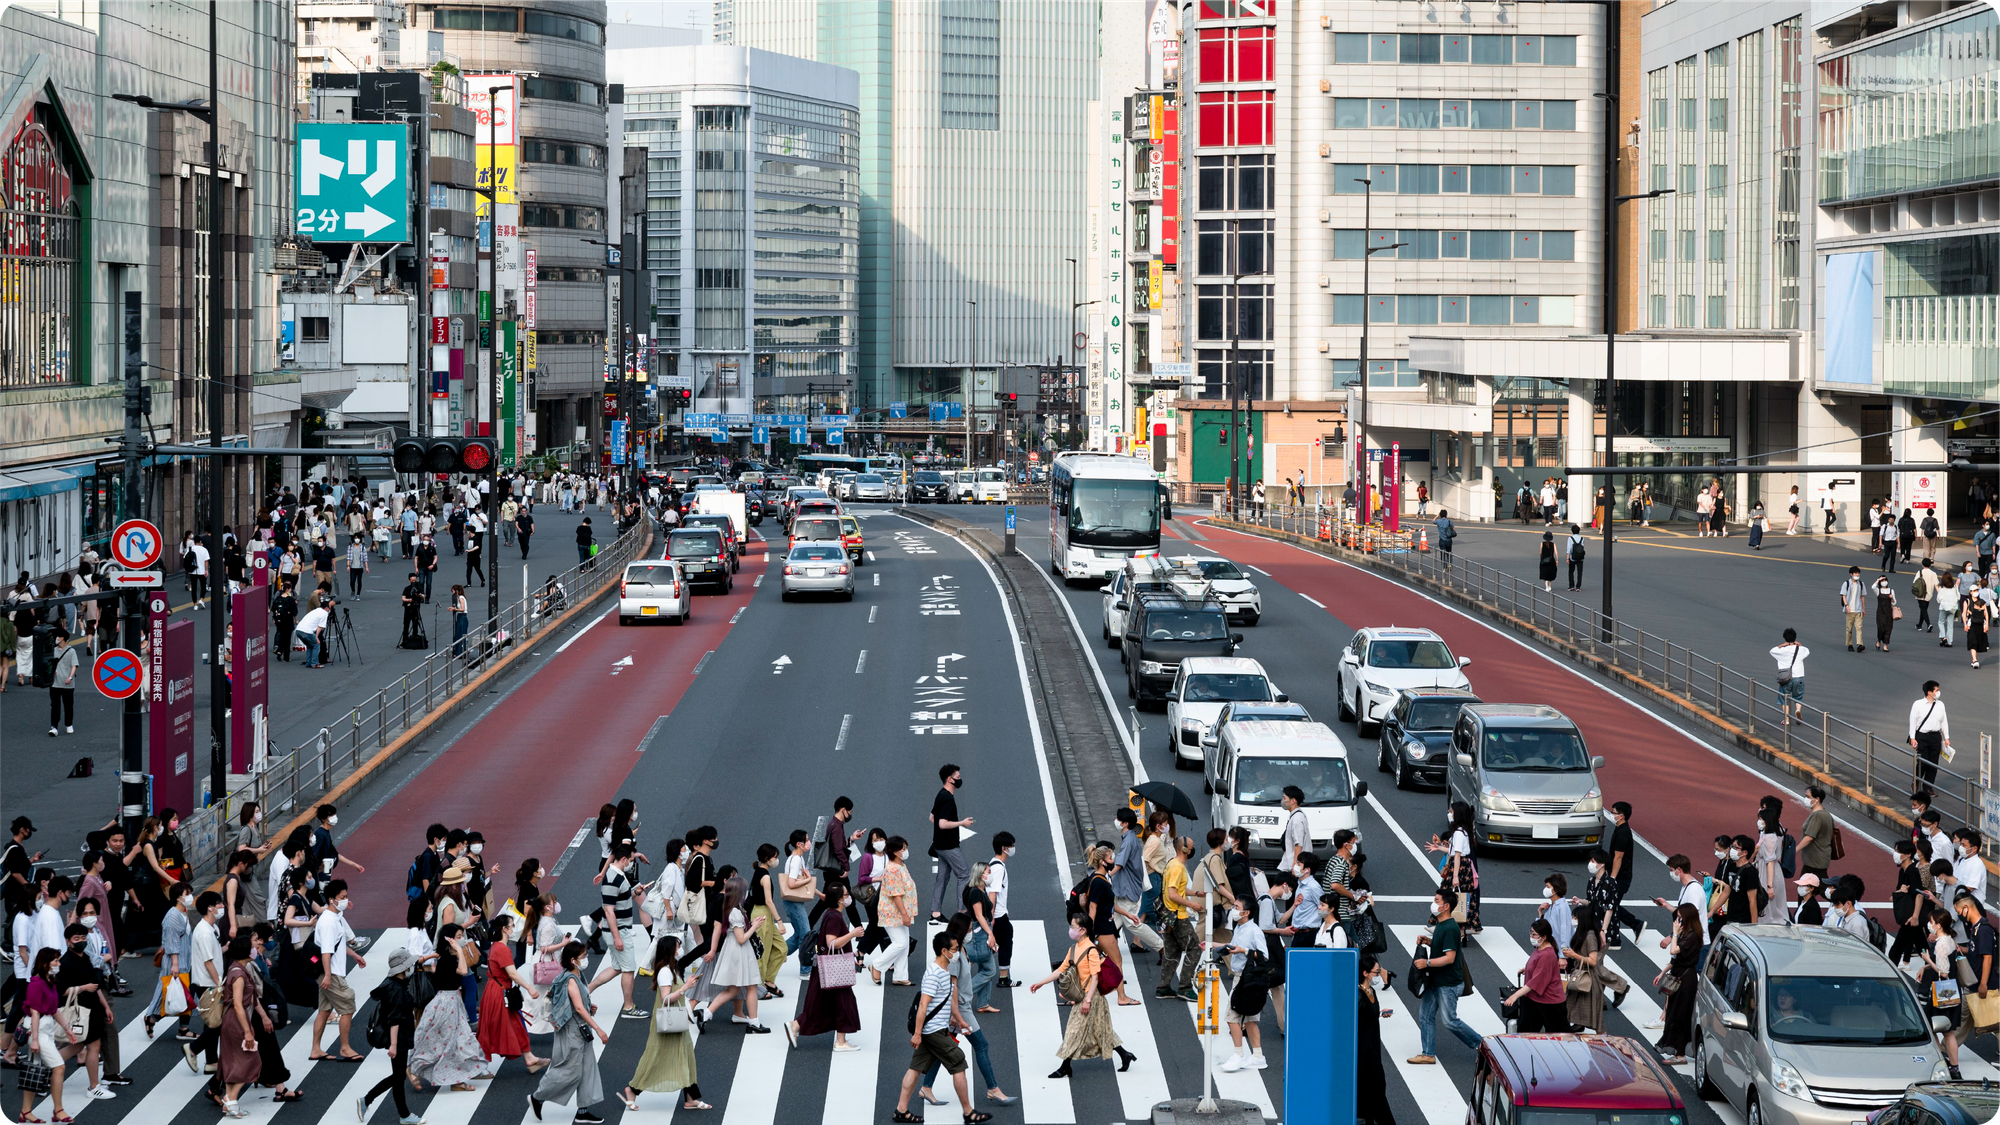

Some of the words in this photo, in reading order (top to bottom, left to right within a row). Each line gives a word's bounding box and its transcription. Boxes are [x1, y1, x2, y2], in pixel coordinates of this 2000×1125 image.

[300, 139, 396, 198] トリ
[298, 209, 340, 233] 2分
[1111, 110, 1122, 304] 豪華カプセルホテル
[495, 225, 517, 237] 告募集
[504, 352, 513, 379] レイク
[1110, 343, 1121, 433] 安心お宿
[451, 401, 459, 436] ユーコ
[153, 620, 163, 702] 新宿駅南口周辺案内
[1240, 816, 1275, 824] 高圧ガス
